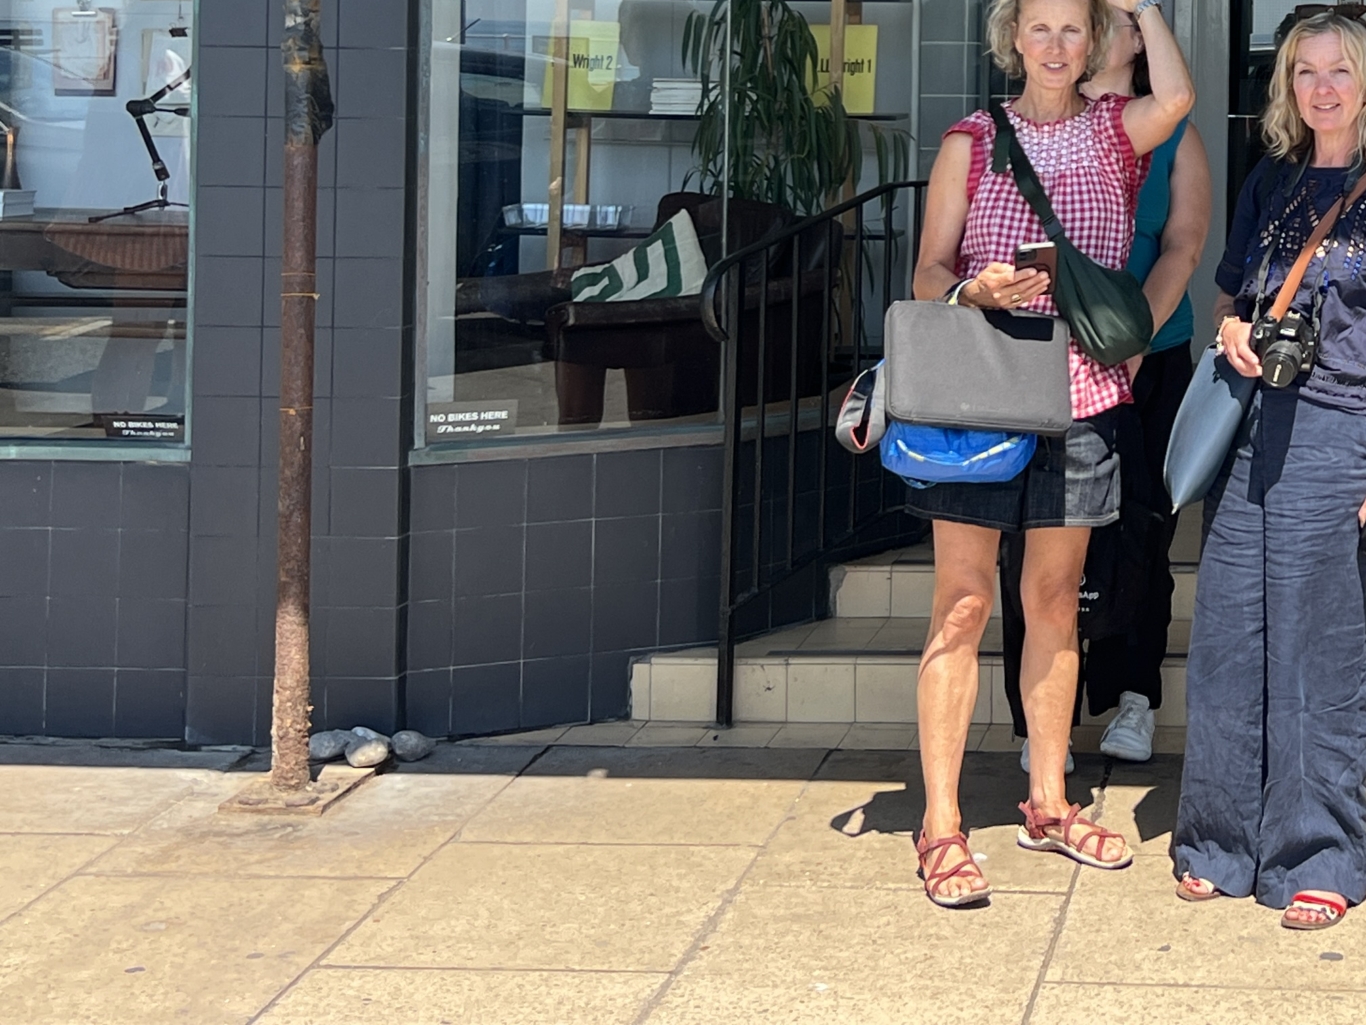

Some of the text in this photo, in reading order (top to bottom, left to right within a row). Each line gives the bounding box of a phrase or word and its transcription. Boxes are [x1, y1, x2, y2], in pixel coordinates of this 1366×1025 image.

[606, 55, 614, 70] 2
[429, 410, 509, 423] NO BIKES HERE
[128, 421, 154, 429] BIKES
